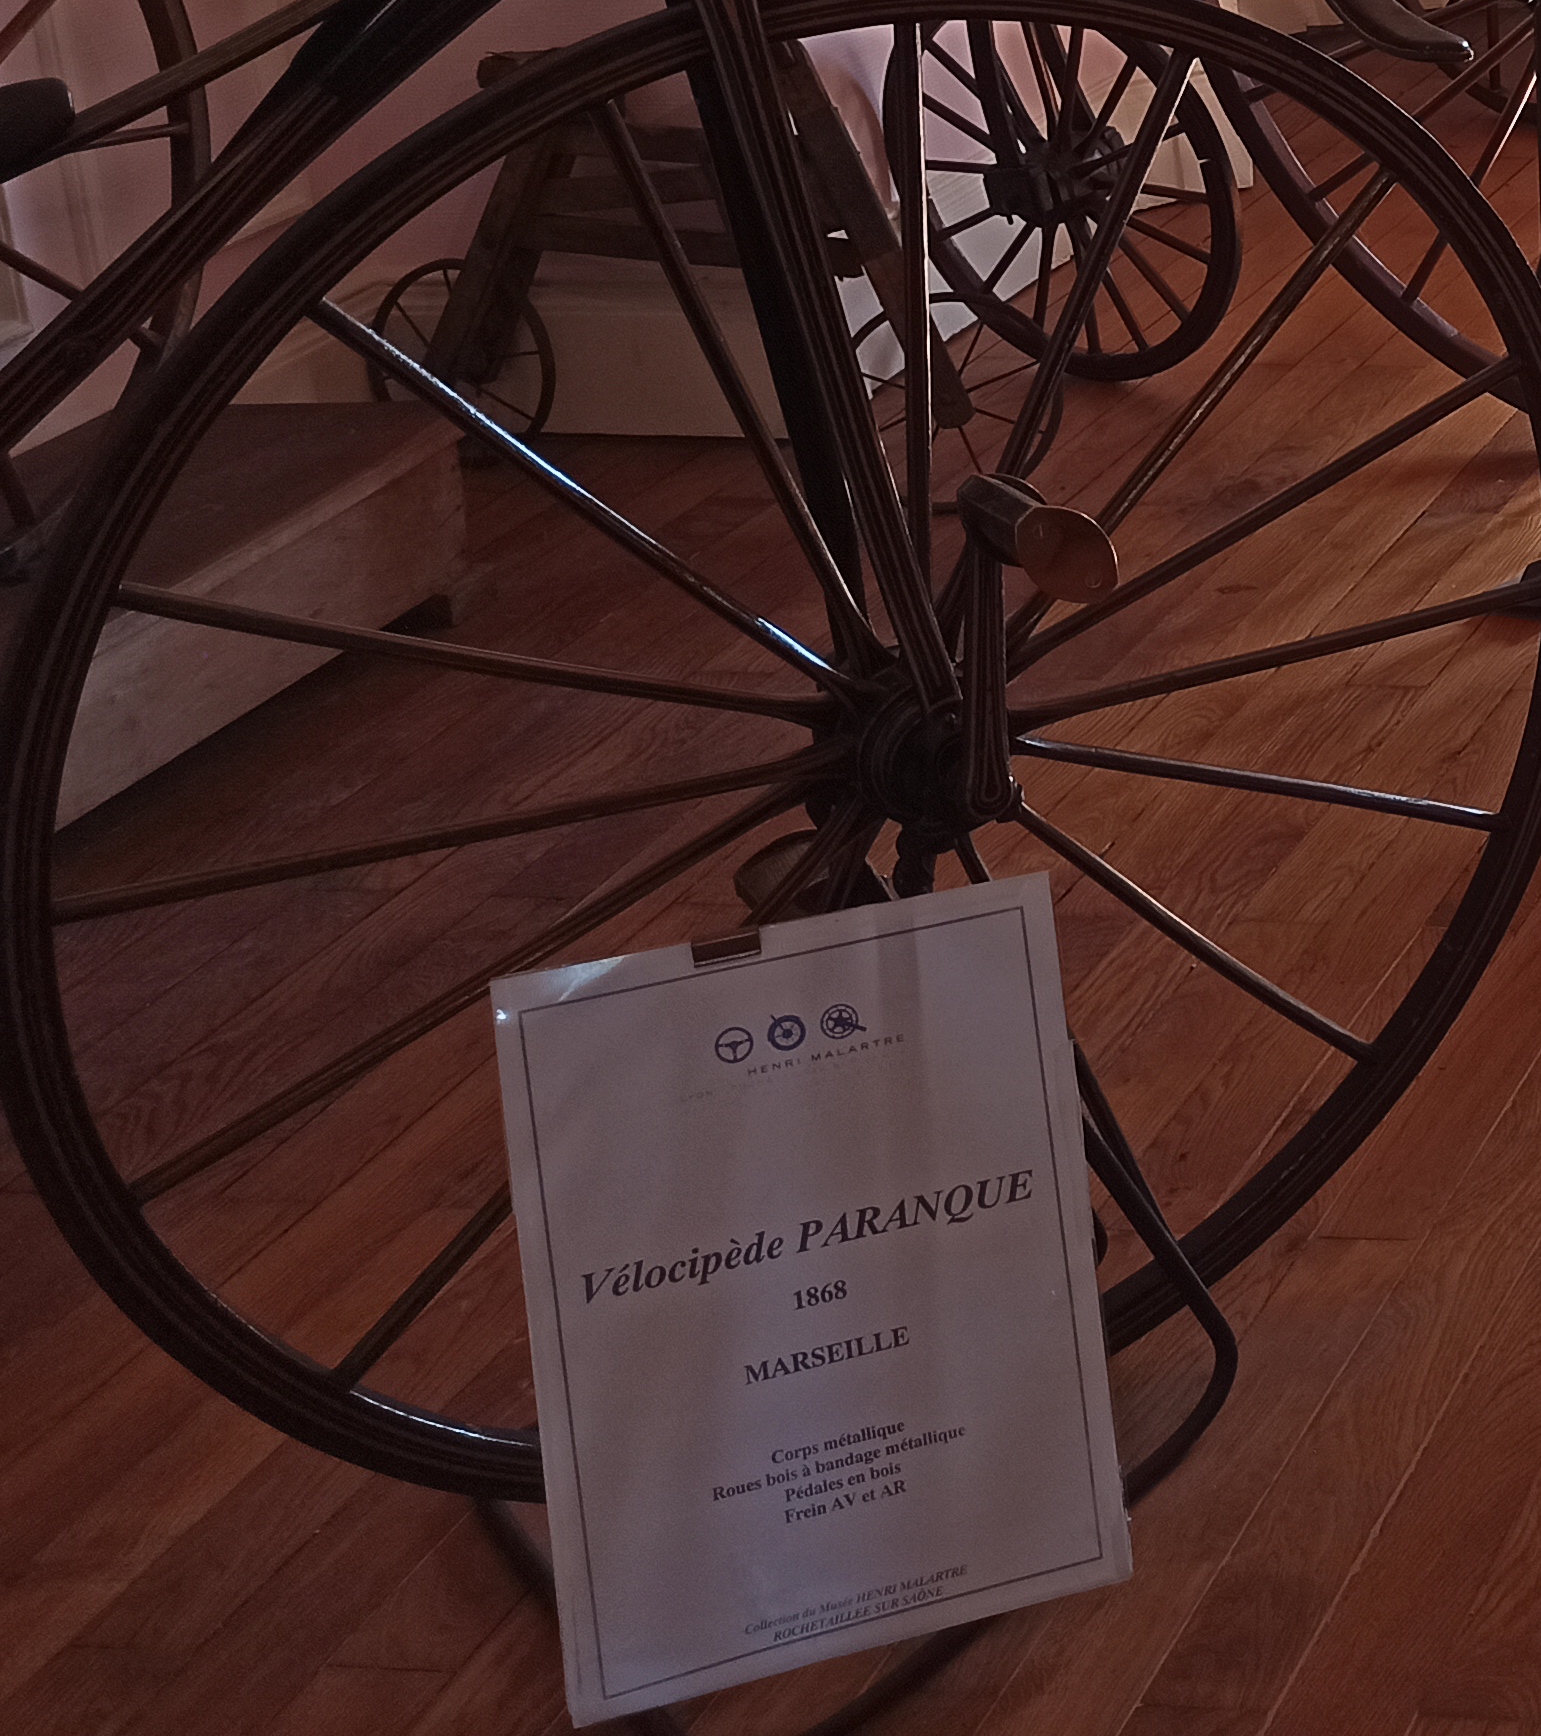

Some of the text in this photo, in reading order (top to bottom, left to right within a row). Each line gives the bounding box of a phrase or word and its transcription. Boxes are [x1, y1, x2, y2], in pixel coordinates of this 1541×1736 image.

[747, 1033, 903, 1076] HENRI MALARTRE
[581, 1169, 1032, 1303] Vélocipède PARANQUE
[793, 1279, 847, 1310] 1868
[743, 1325, 909, 1385] MARSEILLE
[771, 1421, 904, 1463] Corps métallique
[712, 1427, 964, 1501] Roues bois à bandage métallique
[784, 1461, 901, 1502] Pédales en bois
[784, 1479, 906, 1523] Frein AV et AR
